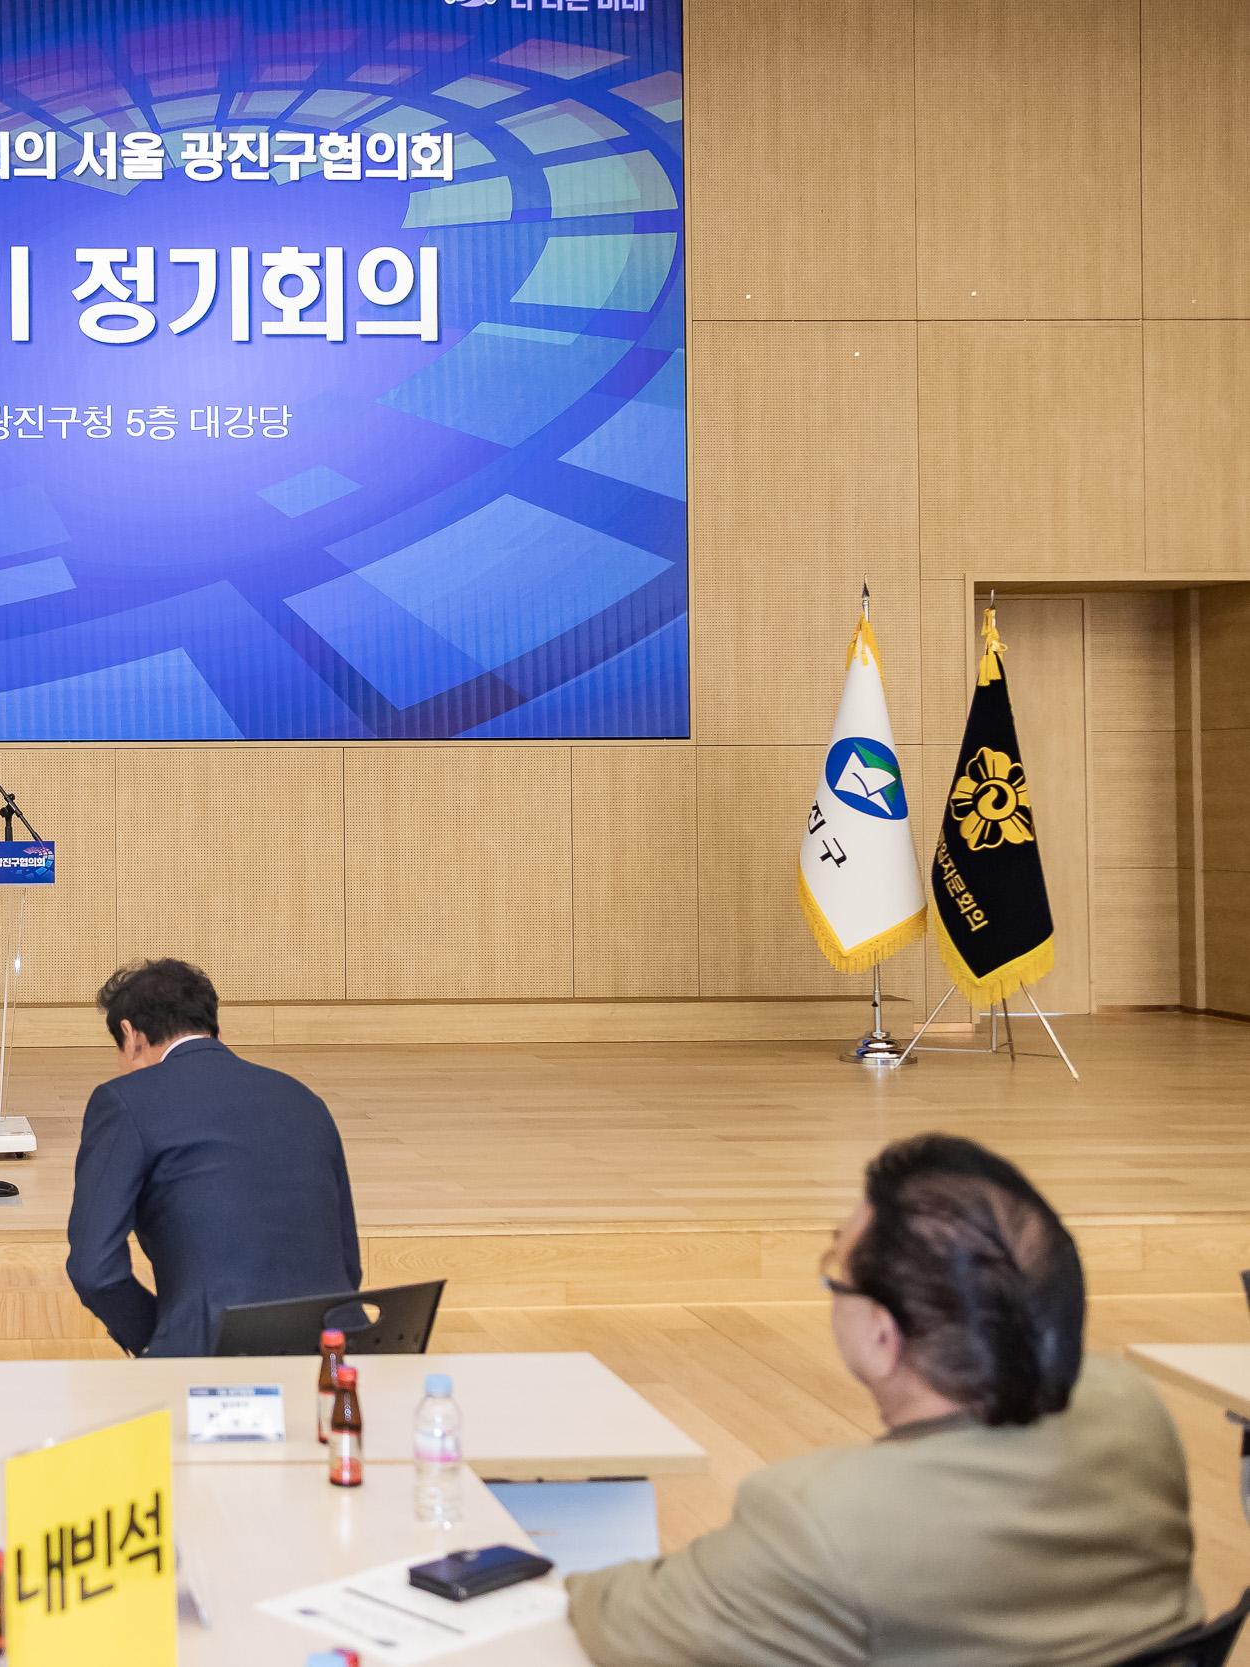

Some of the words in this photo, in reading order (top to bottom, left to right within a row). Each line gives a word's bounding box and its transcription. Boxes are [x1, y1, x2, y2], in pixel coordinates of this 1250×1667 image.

[73, 131, 165, 180] 서울
[180, 131, 454, 182] 광진구협의회
[71, 245, 440, 345] 정기회의
[126, 405, 179, 441] 5층
[190, 404, 293, 442] 대강당
[17, 1491, 162, 1613] 내빈석
